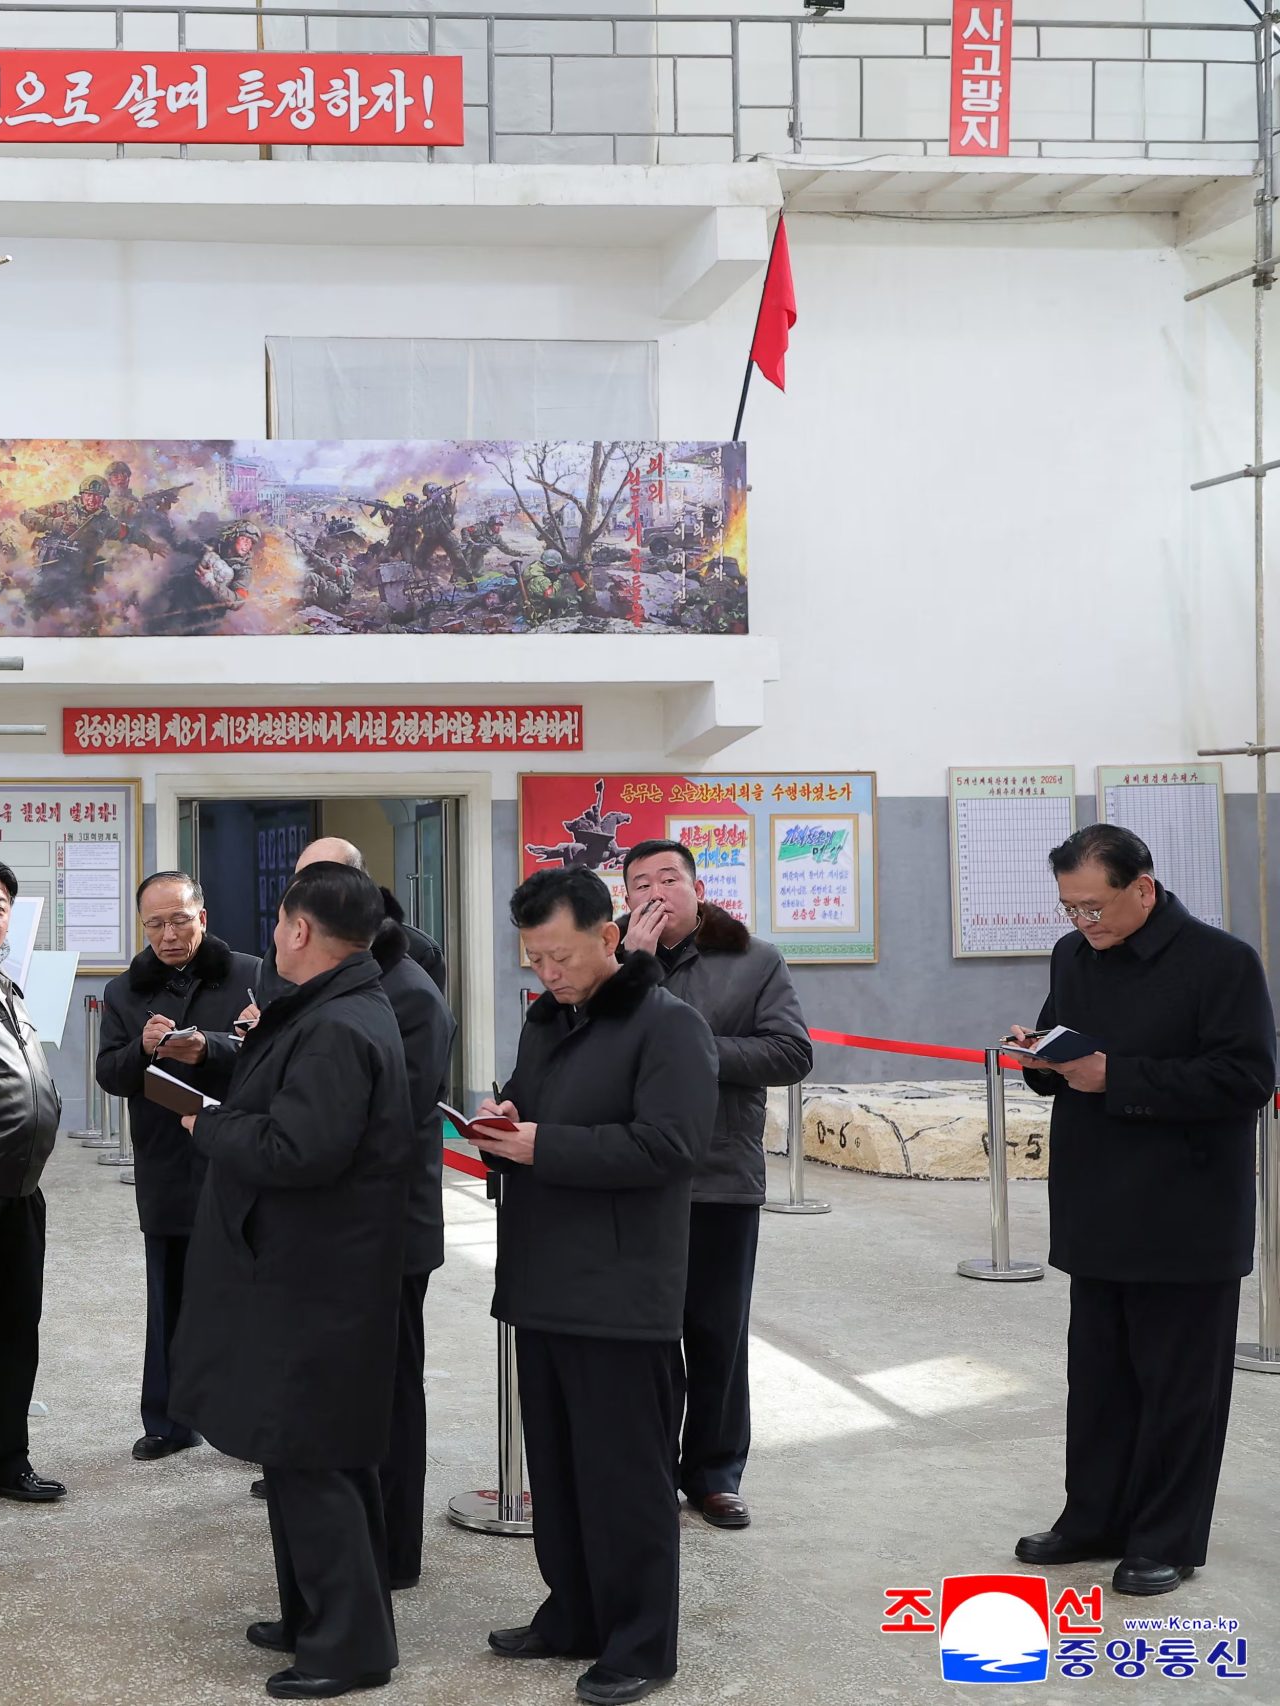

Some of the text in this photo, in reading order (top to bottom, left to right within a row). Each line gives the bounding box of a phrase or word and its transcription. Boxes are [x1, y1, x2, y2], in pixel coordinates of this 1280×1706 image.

[960, 7, 1004, 150] 사고방지
[112, 64, 207, 130] 살며
[226, 66, 435, 133] 투쟁하자!
[74, 713, 161, 748] 당중앙위원회
[162, 712, 207, 748] 제8기
[619, 782, 664, 804] 동무는
[19, 801, 62, 823] 힘있게
